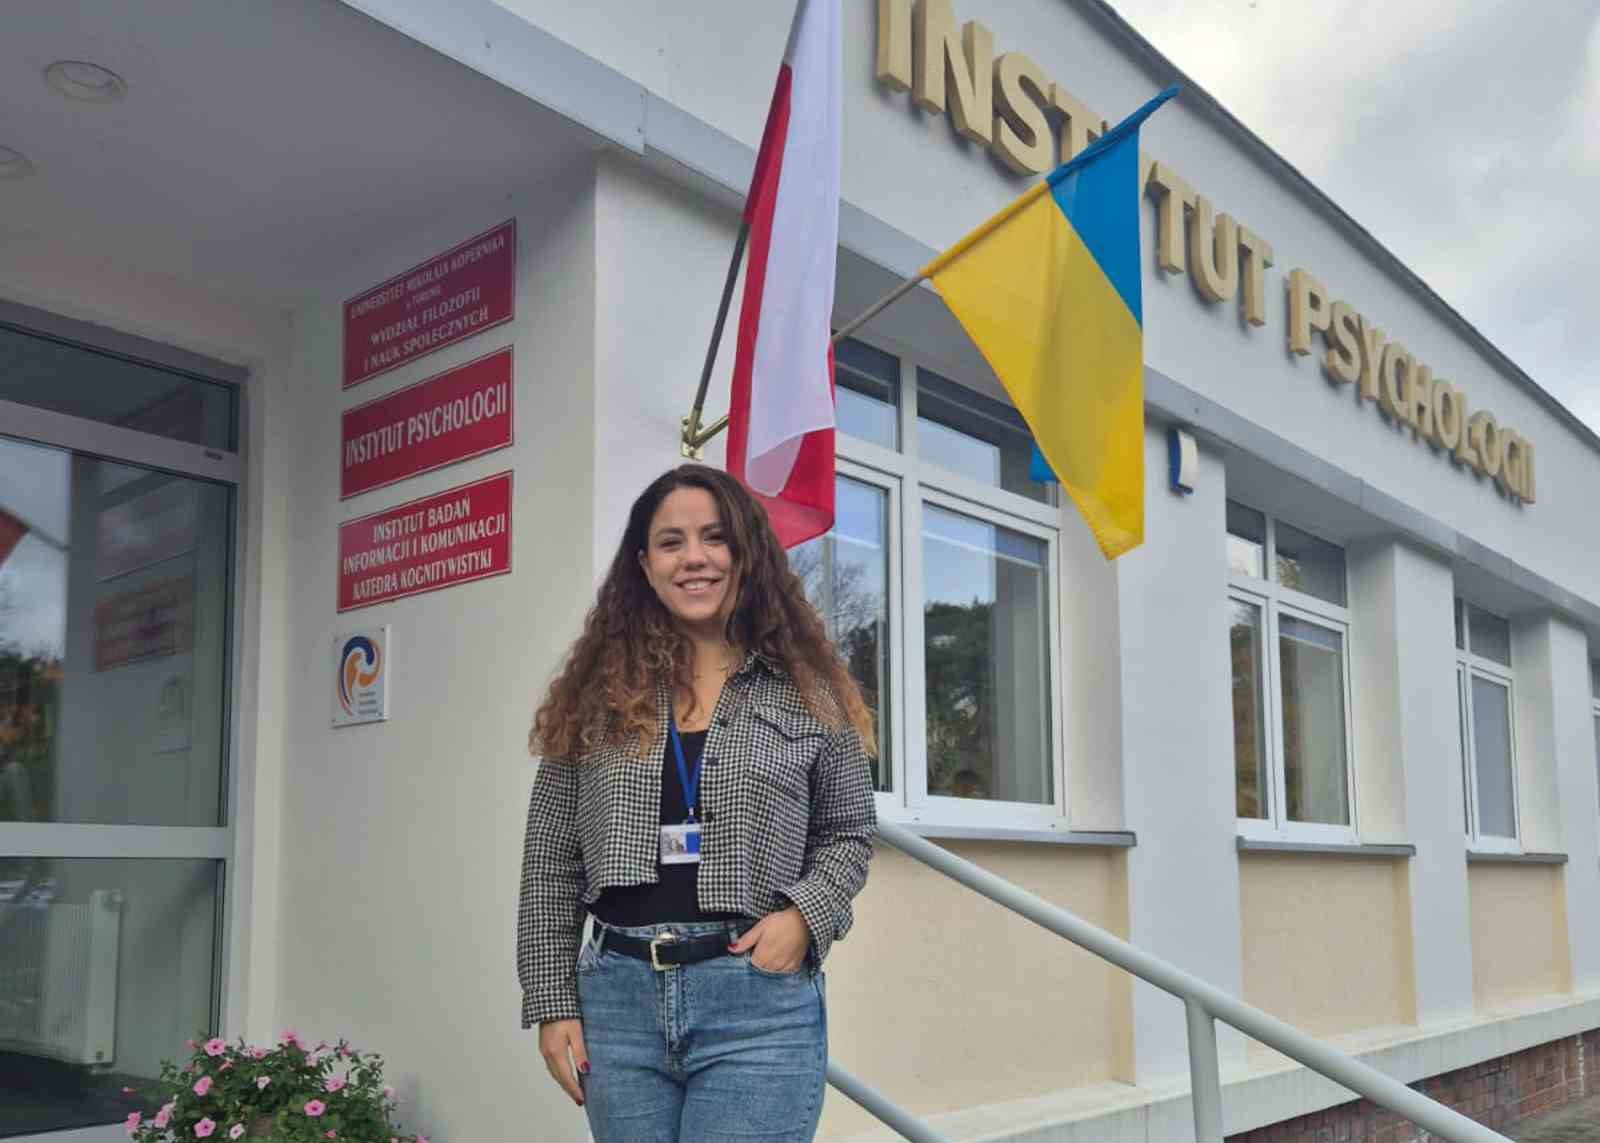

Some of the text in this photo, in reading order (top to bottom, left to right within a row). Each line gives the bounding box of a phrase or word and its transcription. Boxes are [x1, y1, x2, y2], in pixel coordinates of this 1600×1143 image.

[876, 0, 1536, 505] INSTTUT PSYCHOLOGII
[421, 286, 481, 324] FILOZOFII
[370, 347, 402, 369] NAUK
[345, 382, 508, 468] INSTYTUT PSYCHOLOGII
[343, 541, 410, 576] INFORMACJI
[420, 513, 506, 555] KOMUNIKACJI
[373, 511, 424, 543] INSTYTUT
[352, 547, 492, 601] KATEDRA KOGNITYWISTYKI
